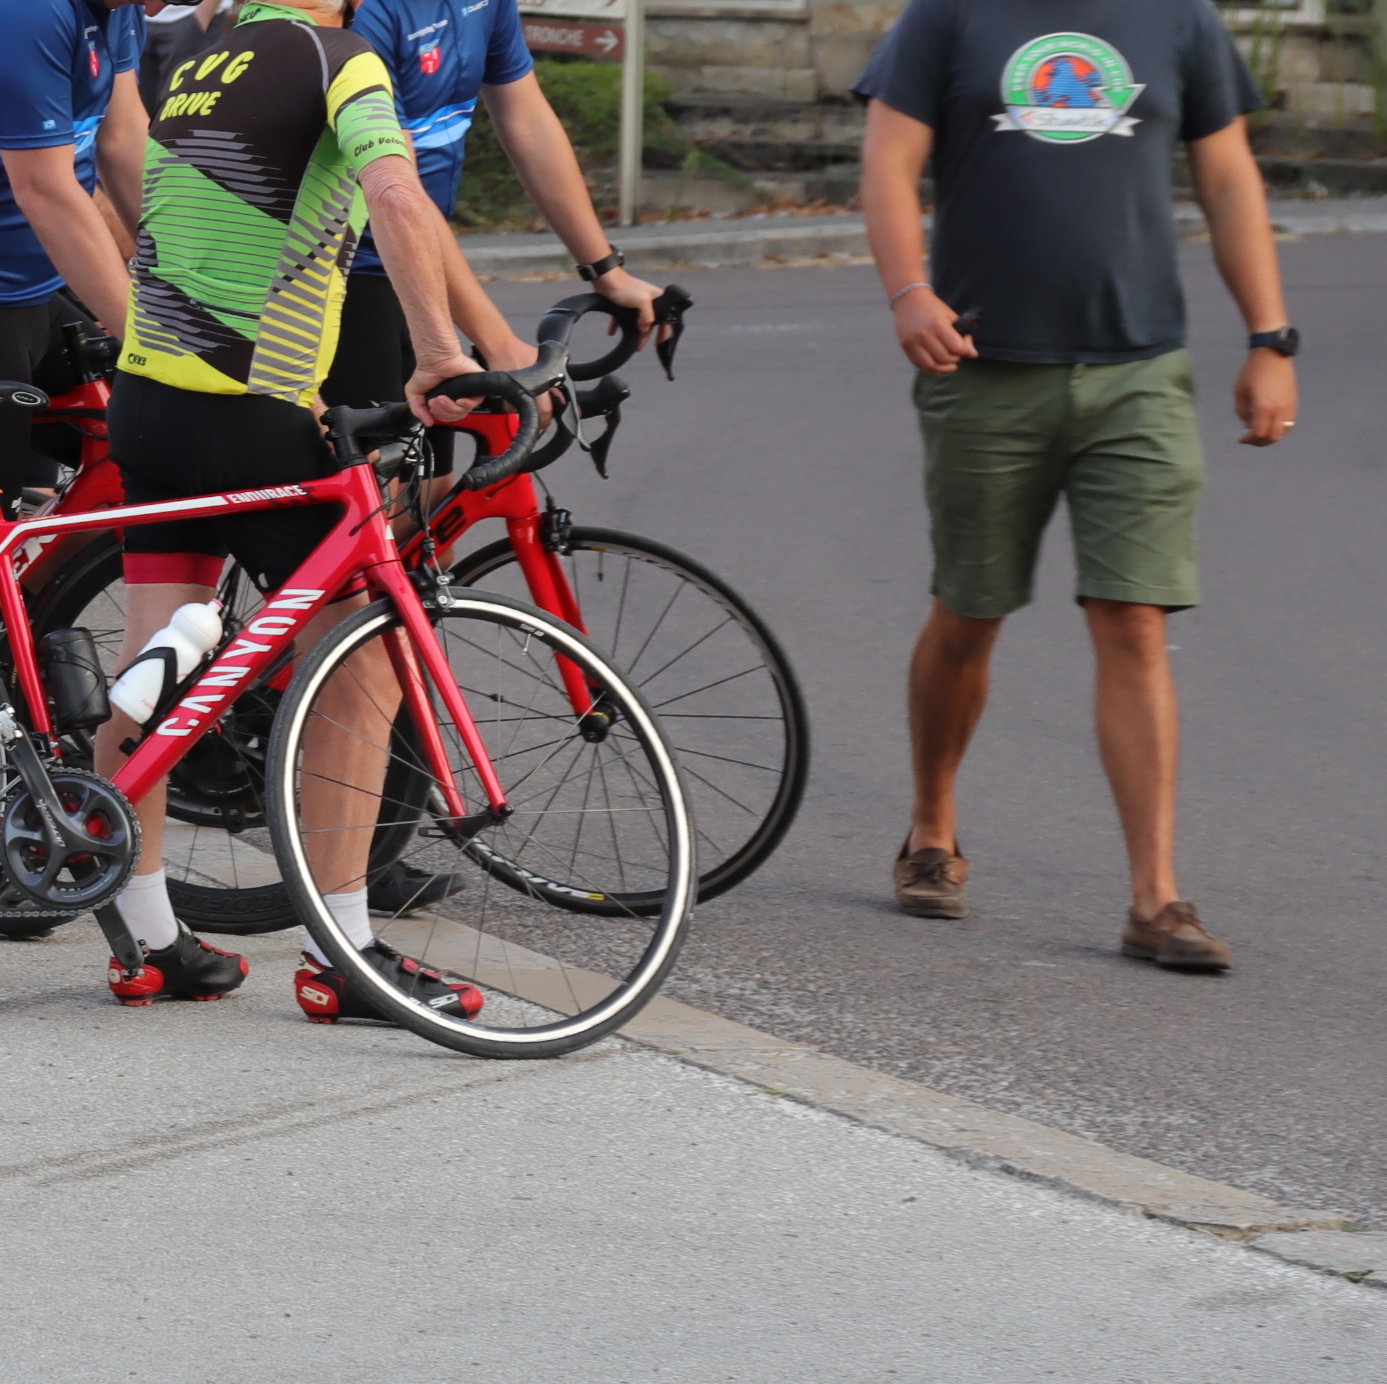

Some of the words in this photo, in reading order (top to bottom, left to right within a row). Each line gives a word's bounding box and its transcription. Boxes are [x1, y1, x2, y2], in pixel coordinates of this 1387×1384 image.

[160, 91, 221, 121] BRIVE
[354, 139, 375, 157] Club
[229, 484, 308, 505] ENDURACE
[156, 588, 326, 737] CANYON
